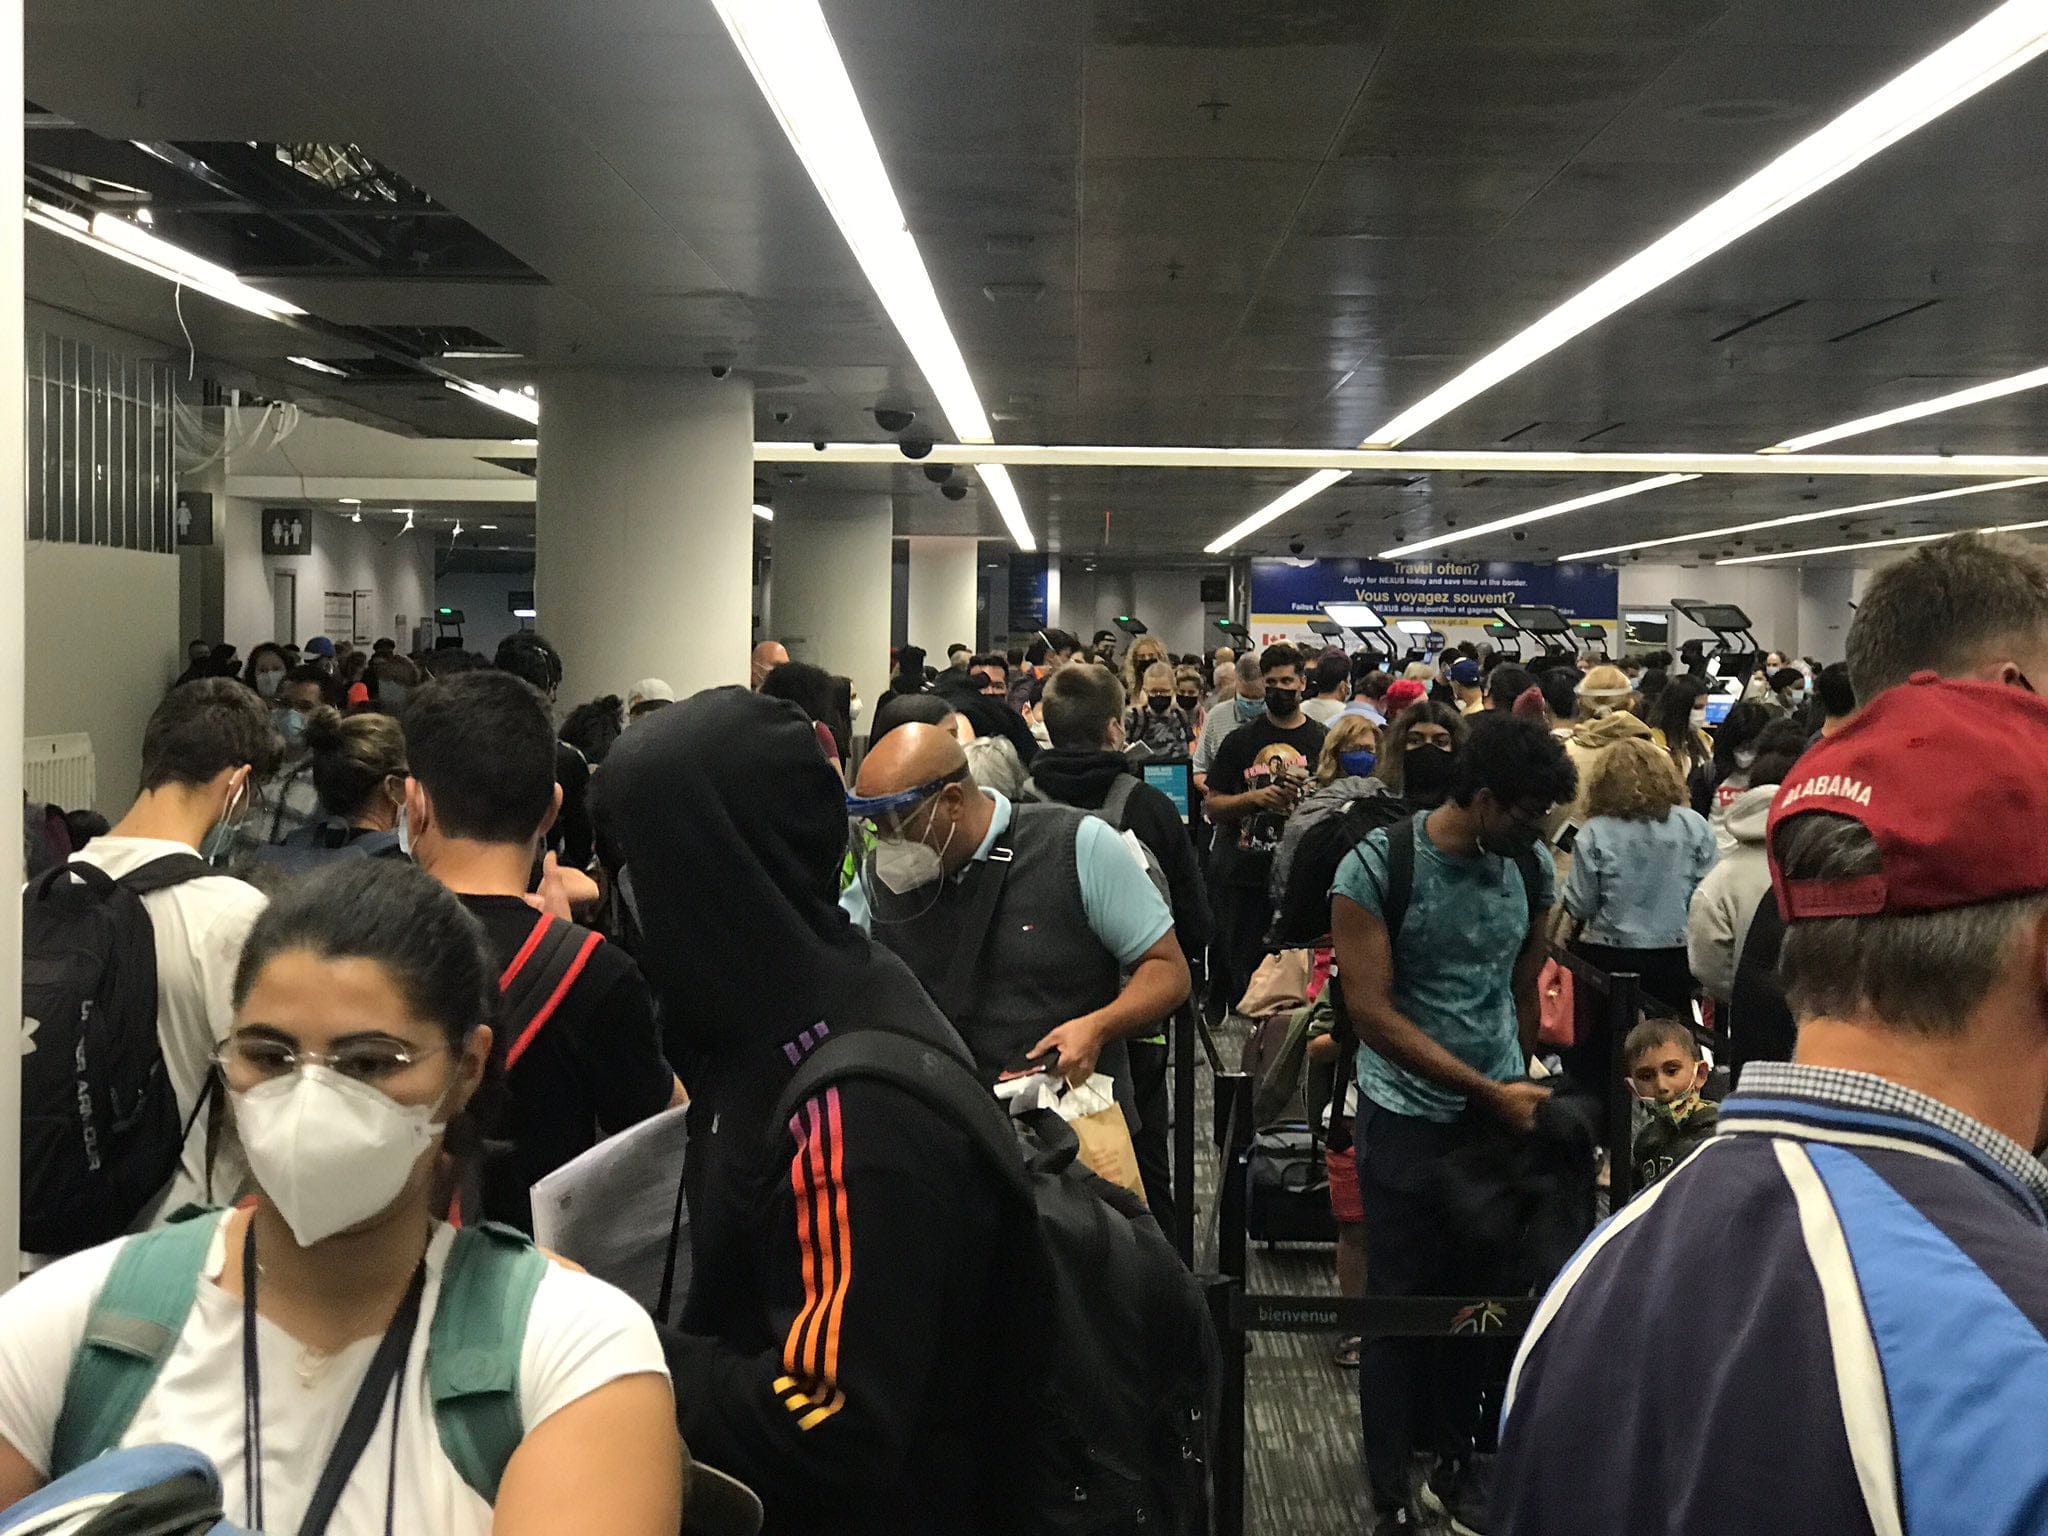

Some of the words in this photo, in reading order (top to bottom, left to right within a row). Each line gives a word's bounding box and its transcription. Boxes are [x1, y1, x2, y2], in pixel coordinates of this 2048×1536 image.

[1393, 562, 1432, 575] Travel
[1437, 563, 1480, 575] often?
[1343, 576, 1365, 585] Apply
[1379, 577, 1405, 585] NEXUS
[1407, 578, 1427, 586] today
[1463, 578, 1478, 586] time
[1502, 579, 1528, 587] border.
[1355, 588, 1390, 602] Vous
[1394, 592, 1449, 605] voyagez
[1453, 591, 1516, 604] souvent?
[1780, 774, 1872, 809] ALABAMA
[1259, 1305, 1338, 1323] bienvenue
